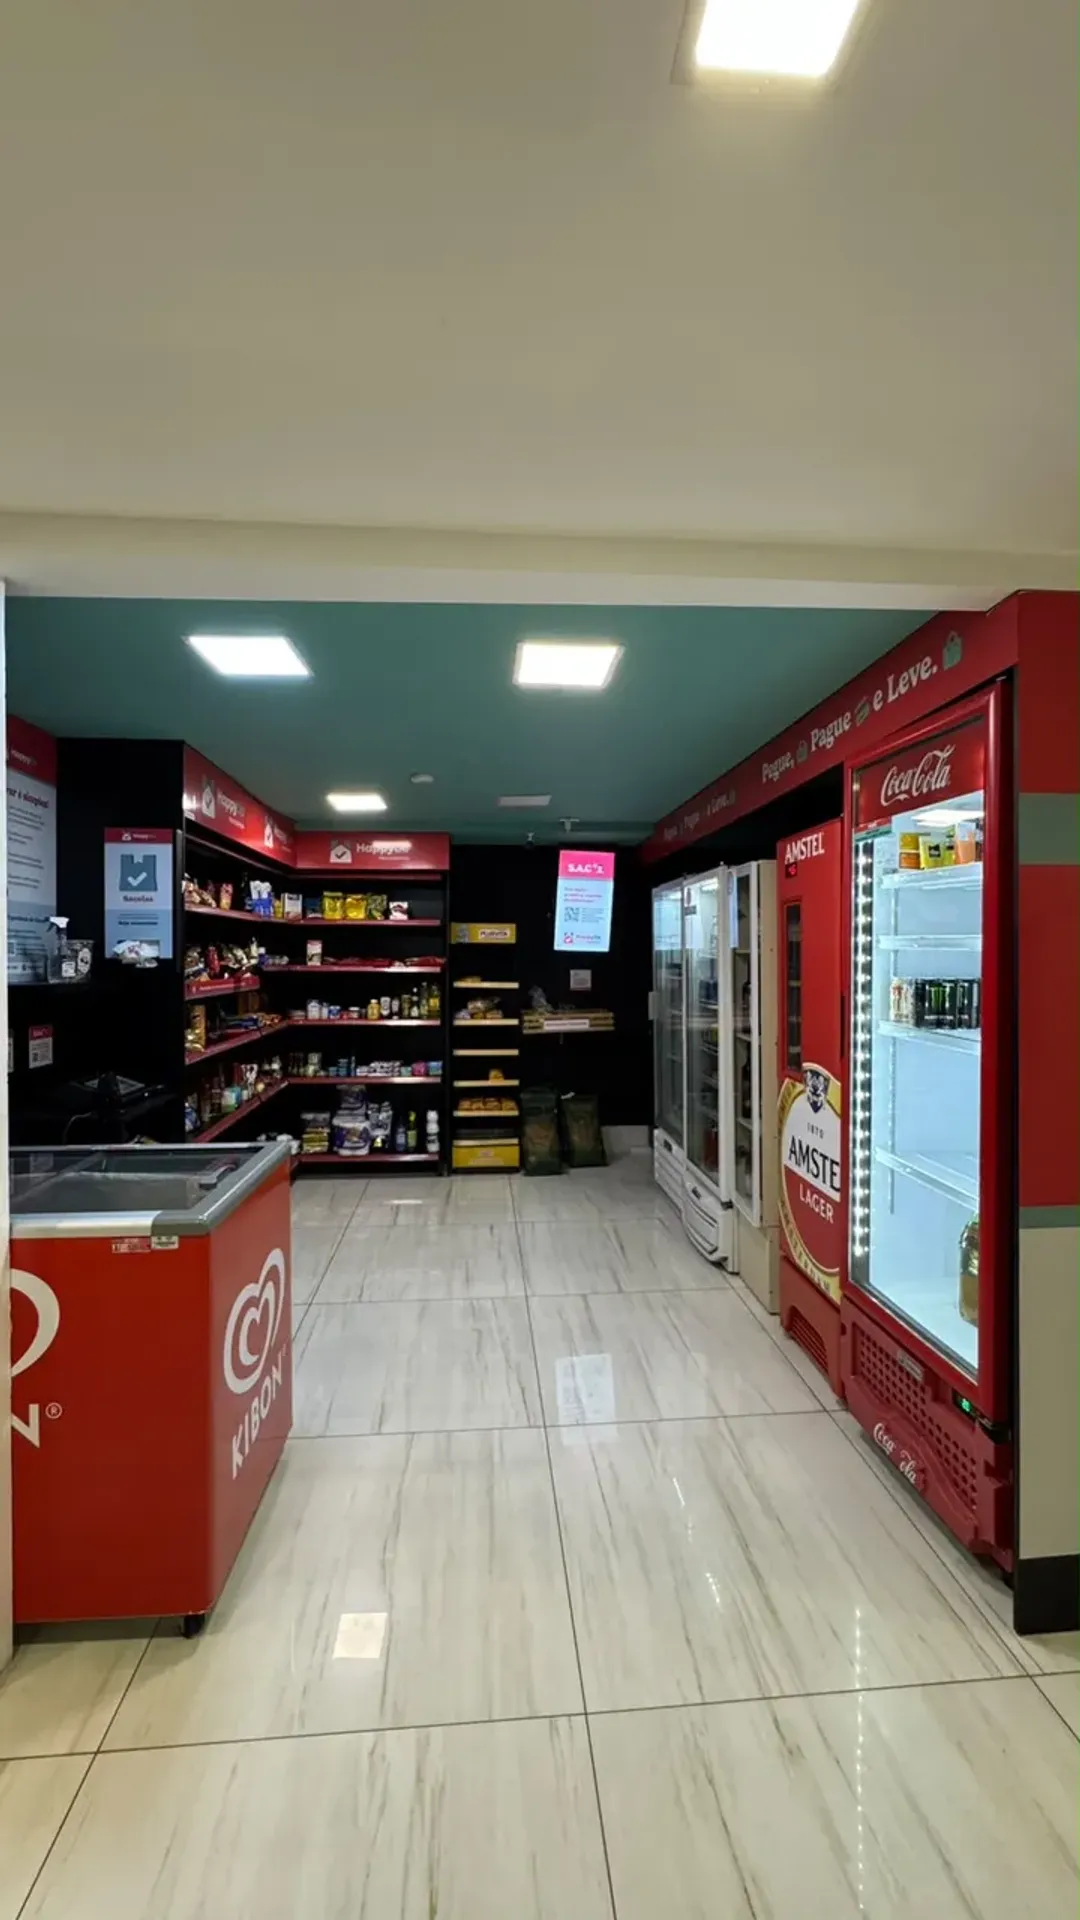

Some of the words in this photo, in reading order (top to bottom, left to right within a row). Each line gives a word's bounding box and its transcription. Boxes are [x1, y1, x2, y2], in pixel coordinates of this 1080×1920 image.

[810, 711, 852, 753] Pague
[873, 689, 884, 712] e
[887, 656, 938, 704] Leve.
[784, 831, 825, 866] AMSTEL
[800, 1182, 834, 1224] LAGER
[232, 1351, 282, 1481] KIBON
